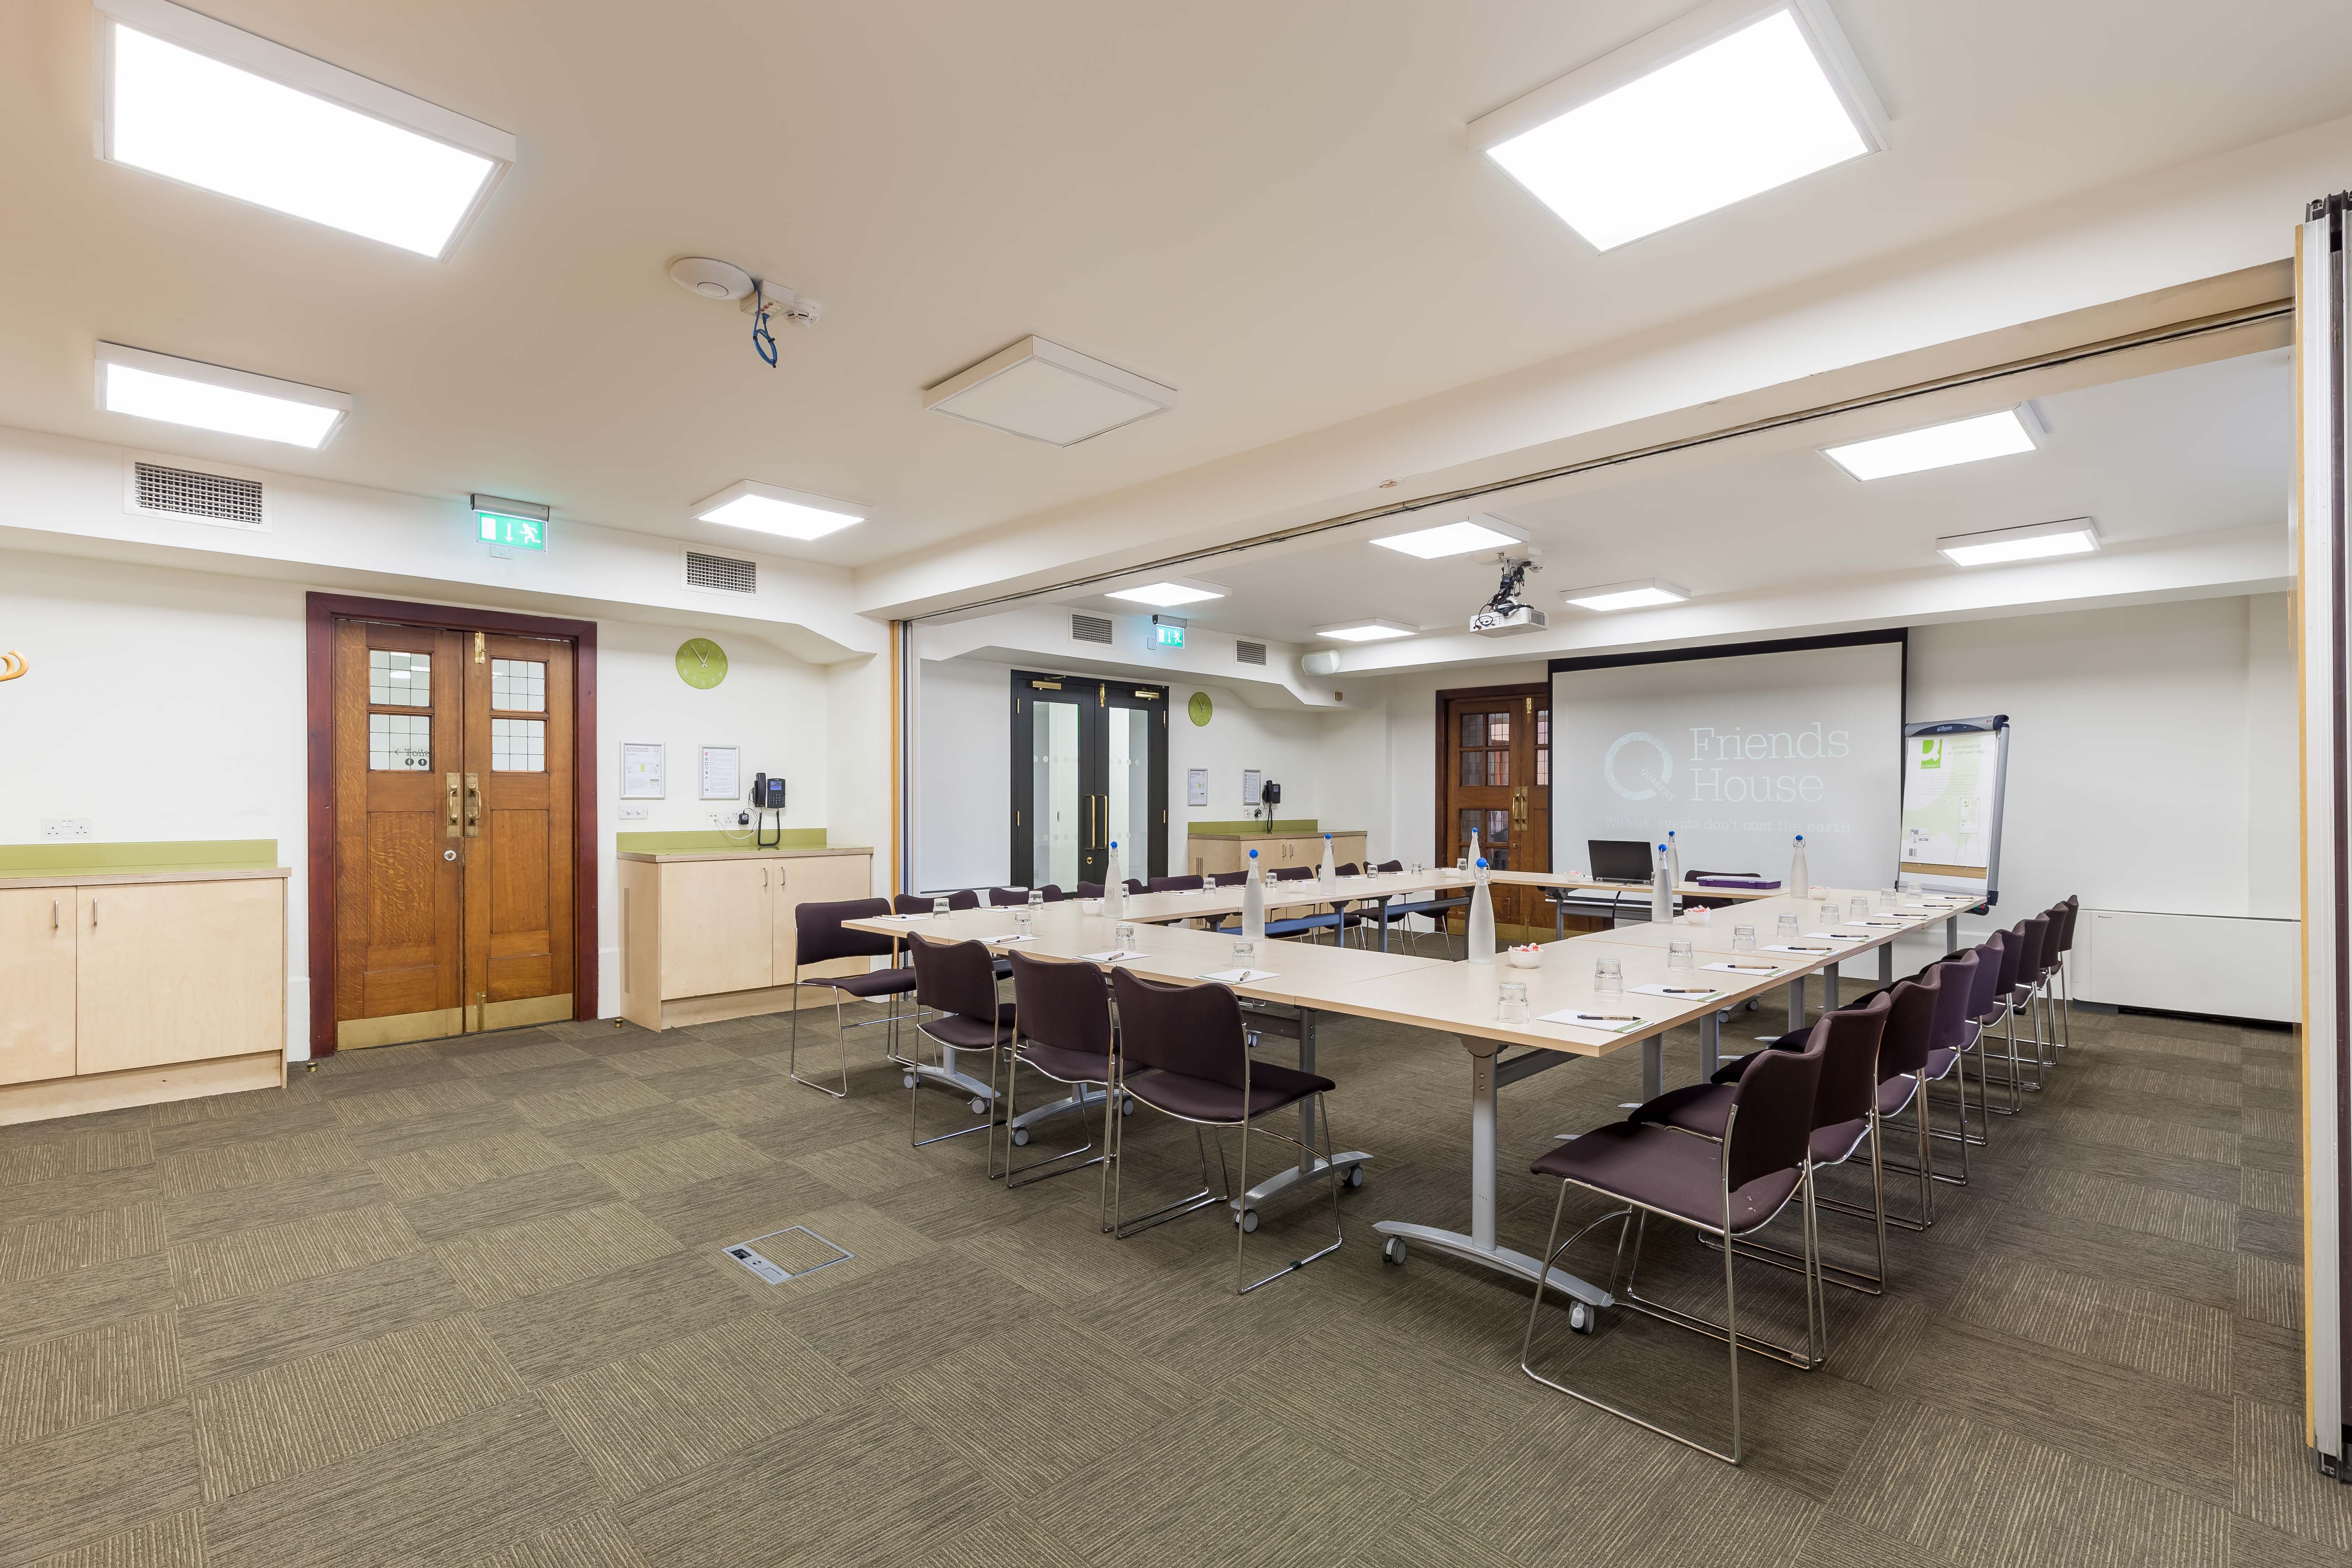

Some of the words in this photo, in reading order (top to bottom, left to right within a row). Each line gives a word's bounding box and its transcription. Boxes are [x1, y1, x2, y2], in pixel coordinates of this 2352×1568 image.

[1689, 722, 1850, 761] Friends
[1640, 769, 1675, 801] QUAKERS
[1690, 767, 1824, 802] House
[1605, 816, 1632, 828] With
[1636, 819, 1653, 830] us,
[1656, 819, 1700, 830] events
[1703, 817, 1739, 830] don't
[1743, 820, 1773, 831] cost
[1777, 820, 1801, 832] the
[1807, 822, 1851, 833] earth
